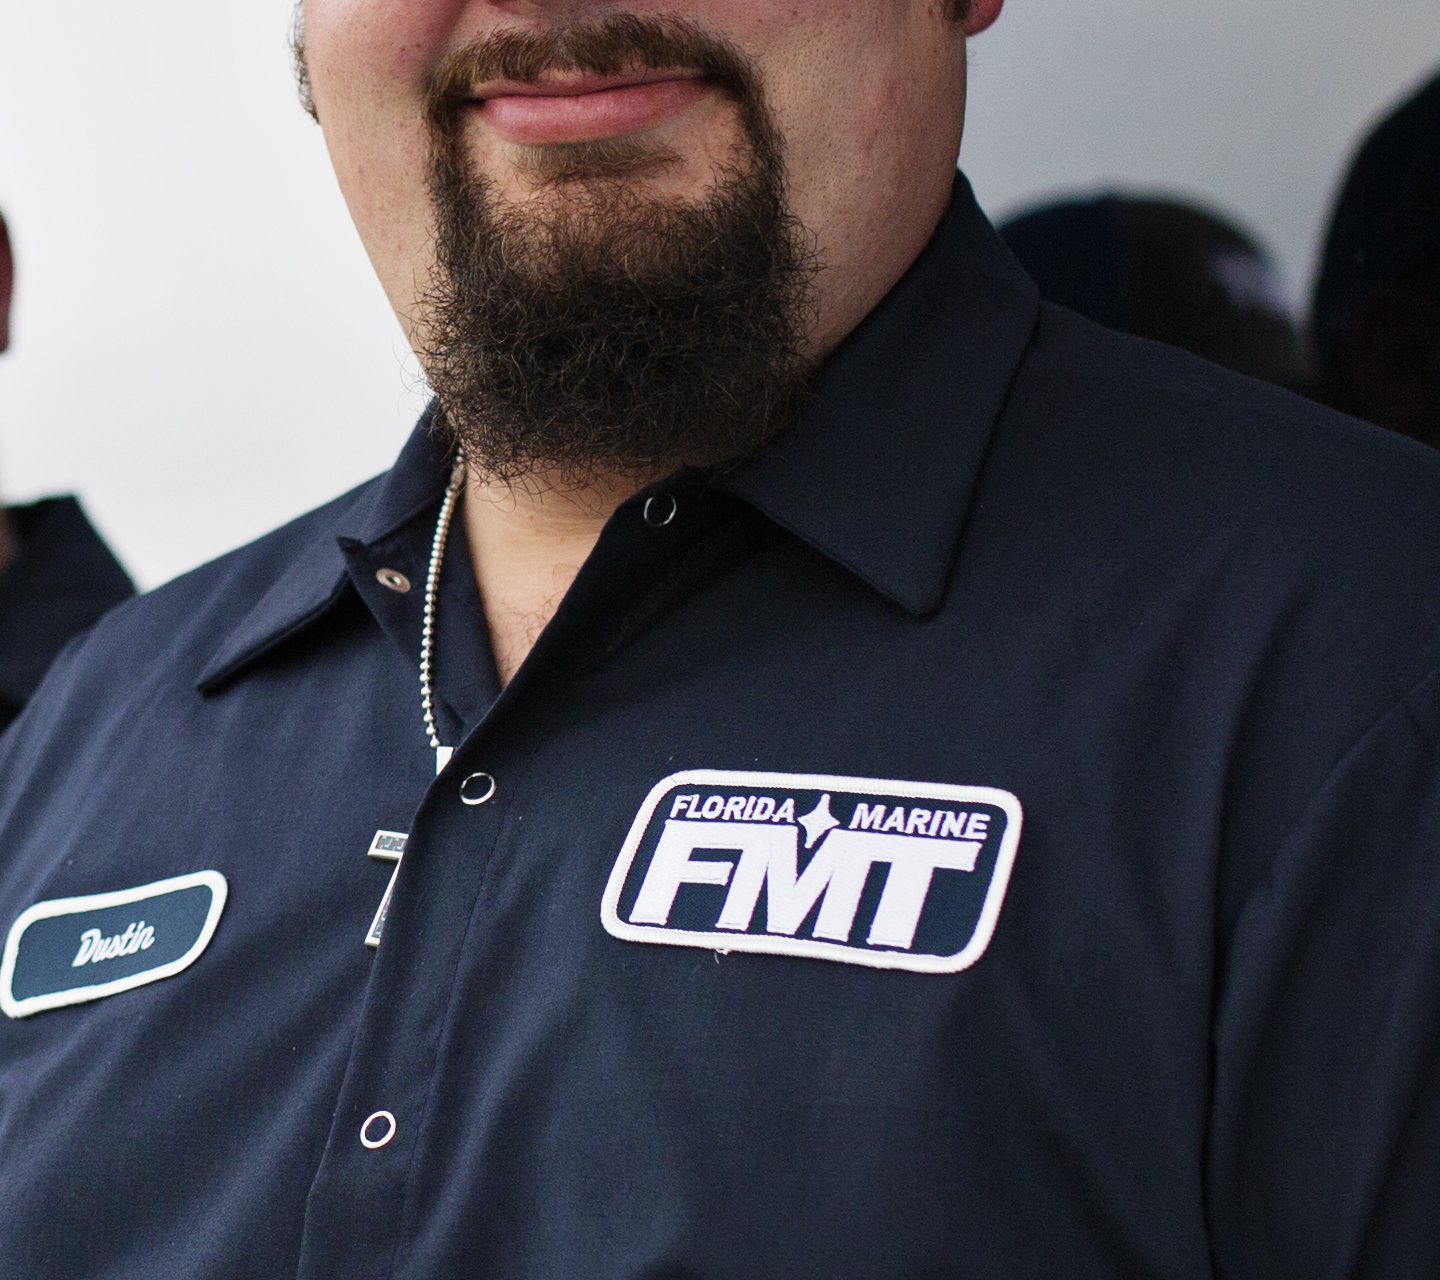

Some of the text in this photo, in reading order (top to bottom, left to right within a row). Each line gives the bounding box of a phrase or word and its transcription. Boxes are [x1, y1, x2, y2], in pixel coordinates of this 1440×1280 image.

[669, 793, 992, 840] FLORIDA MARINE
[628, 819, 983, 950] FMT
[71, 920, 156, 968] Dustin
